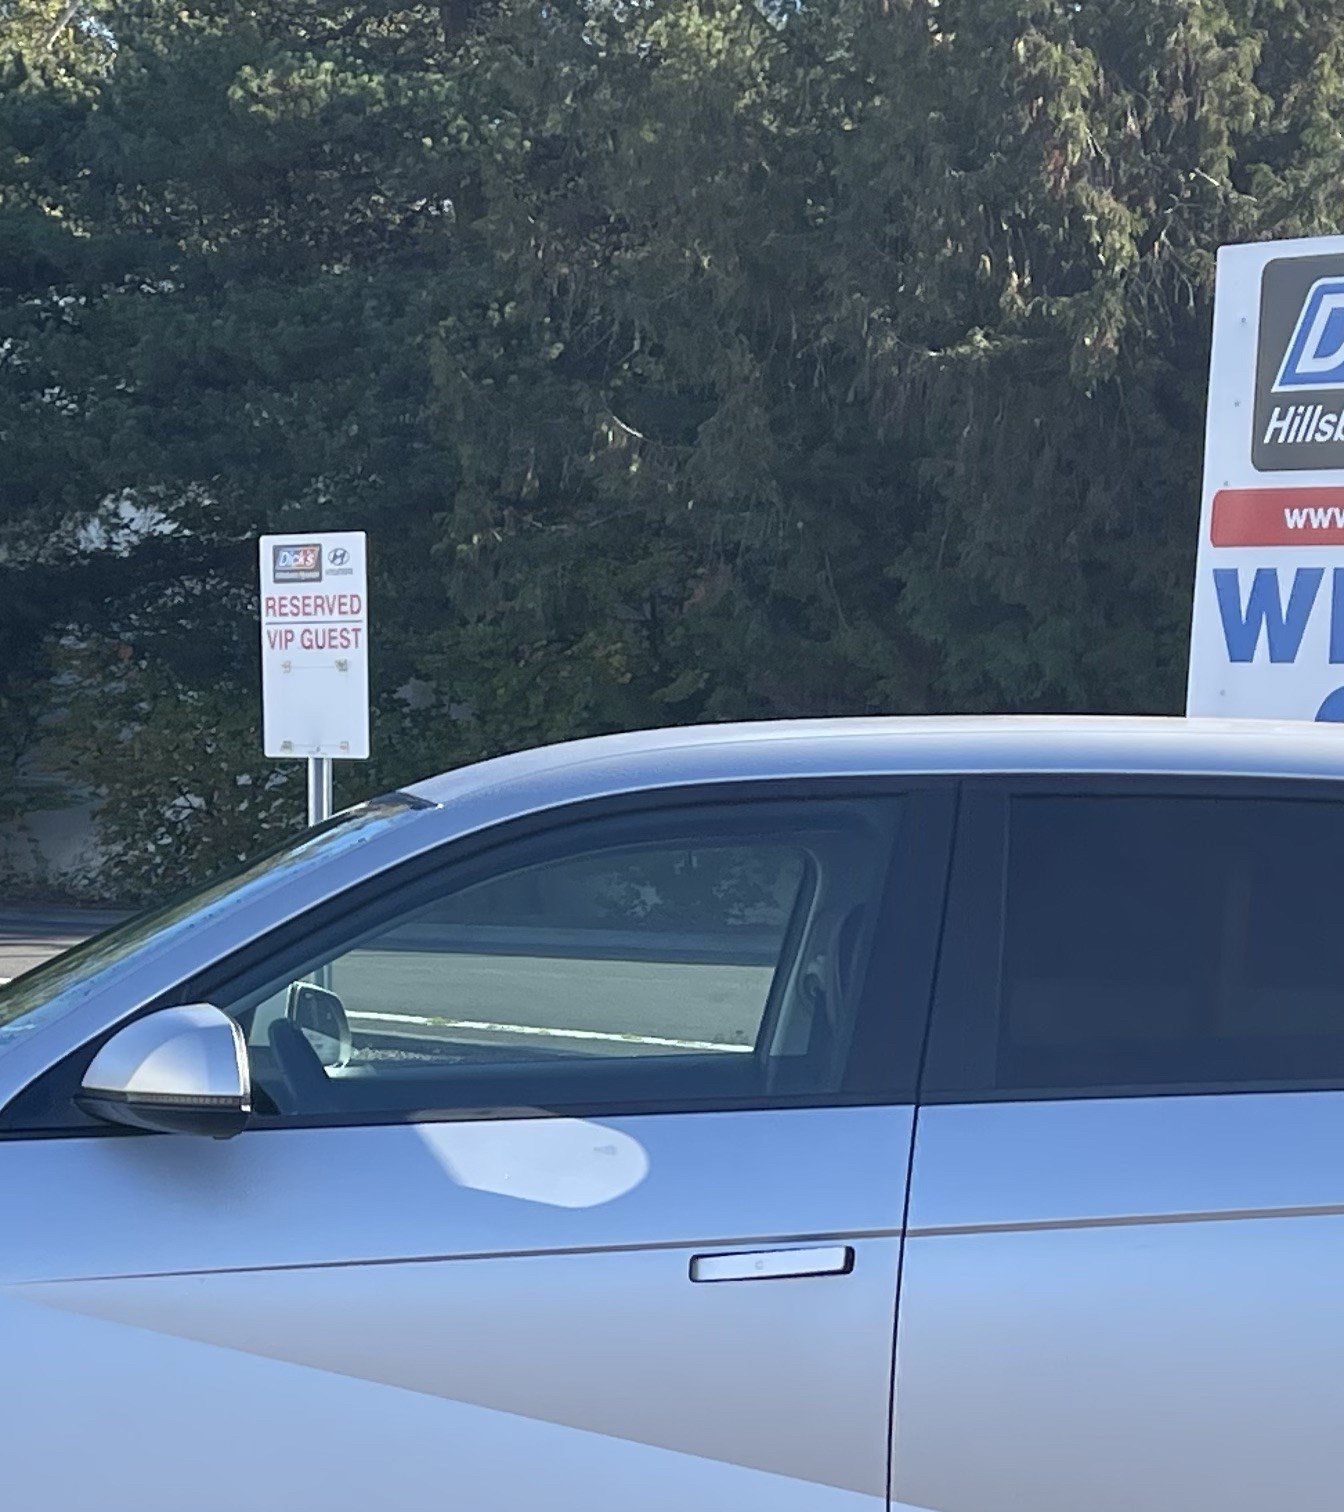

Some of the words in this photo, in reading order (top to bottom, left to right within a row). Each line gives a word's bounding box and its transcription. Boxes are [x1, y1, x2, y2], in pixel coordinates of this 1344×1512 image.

[265, 594, 362, 617] RESERVED
[267, 629, 294, 650] VIP
[300, 628, 362, 650] GUEST
